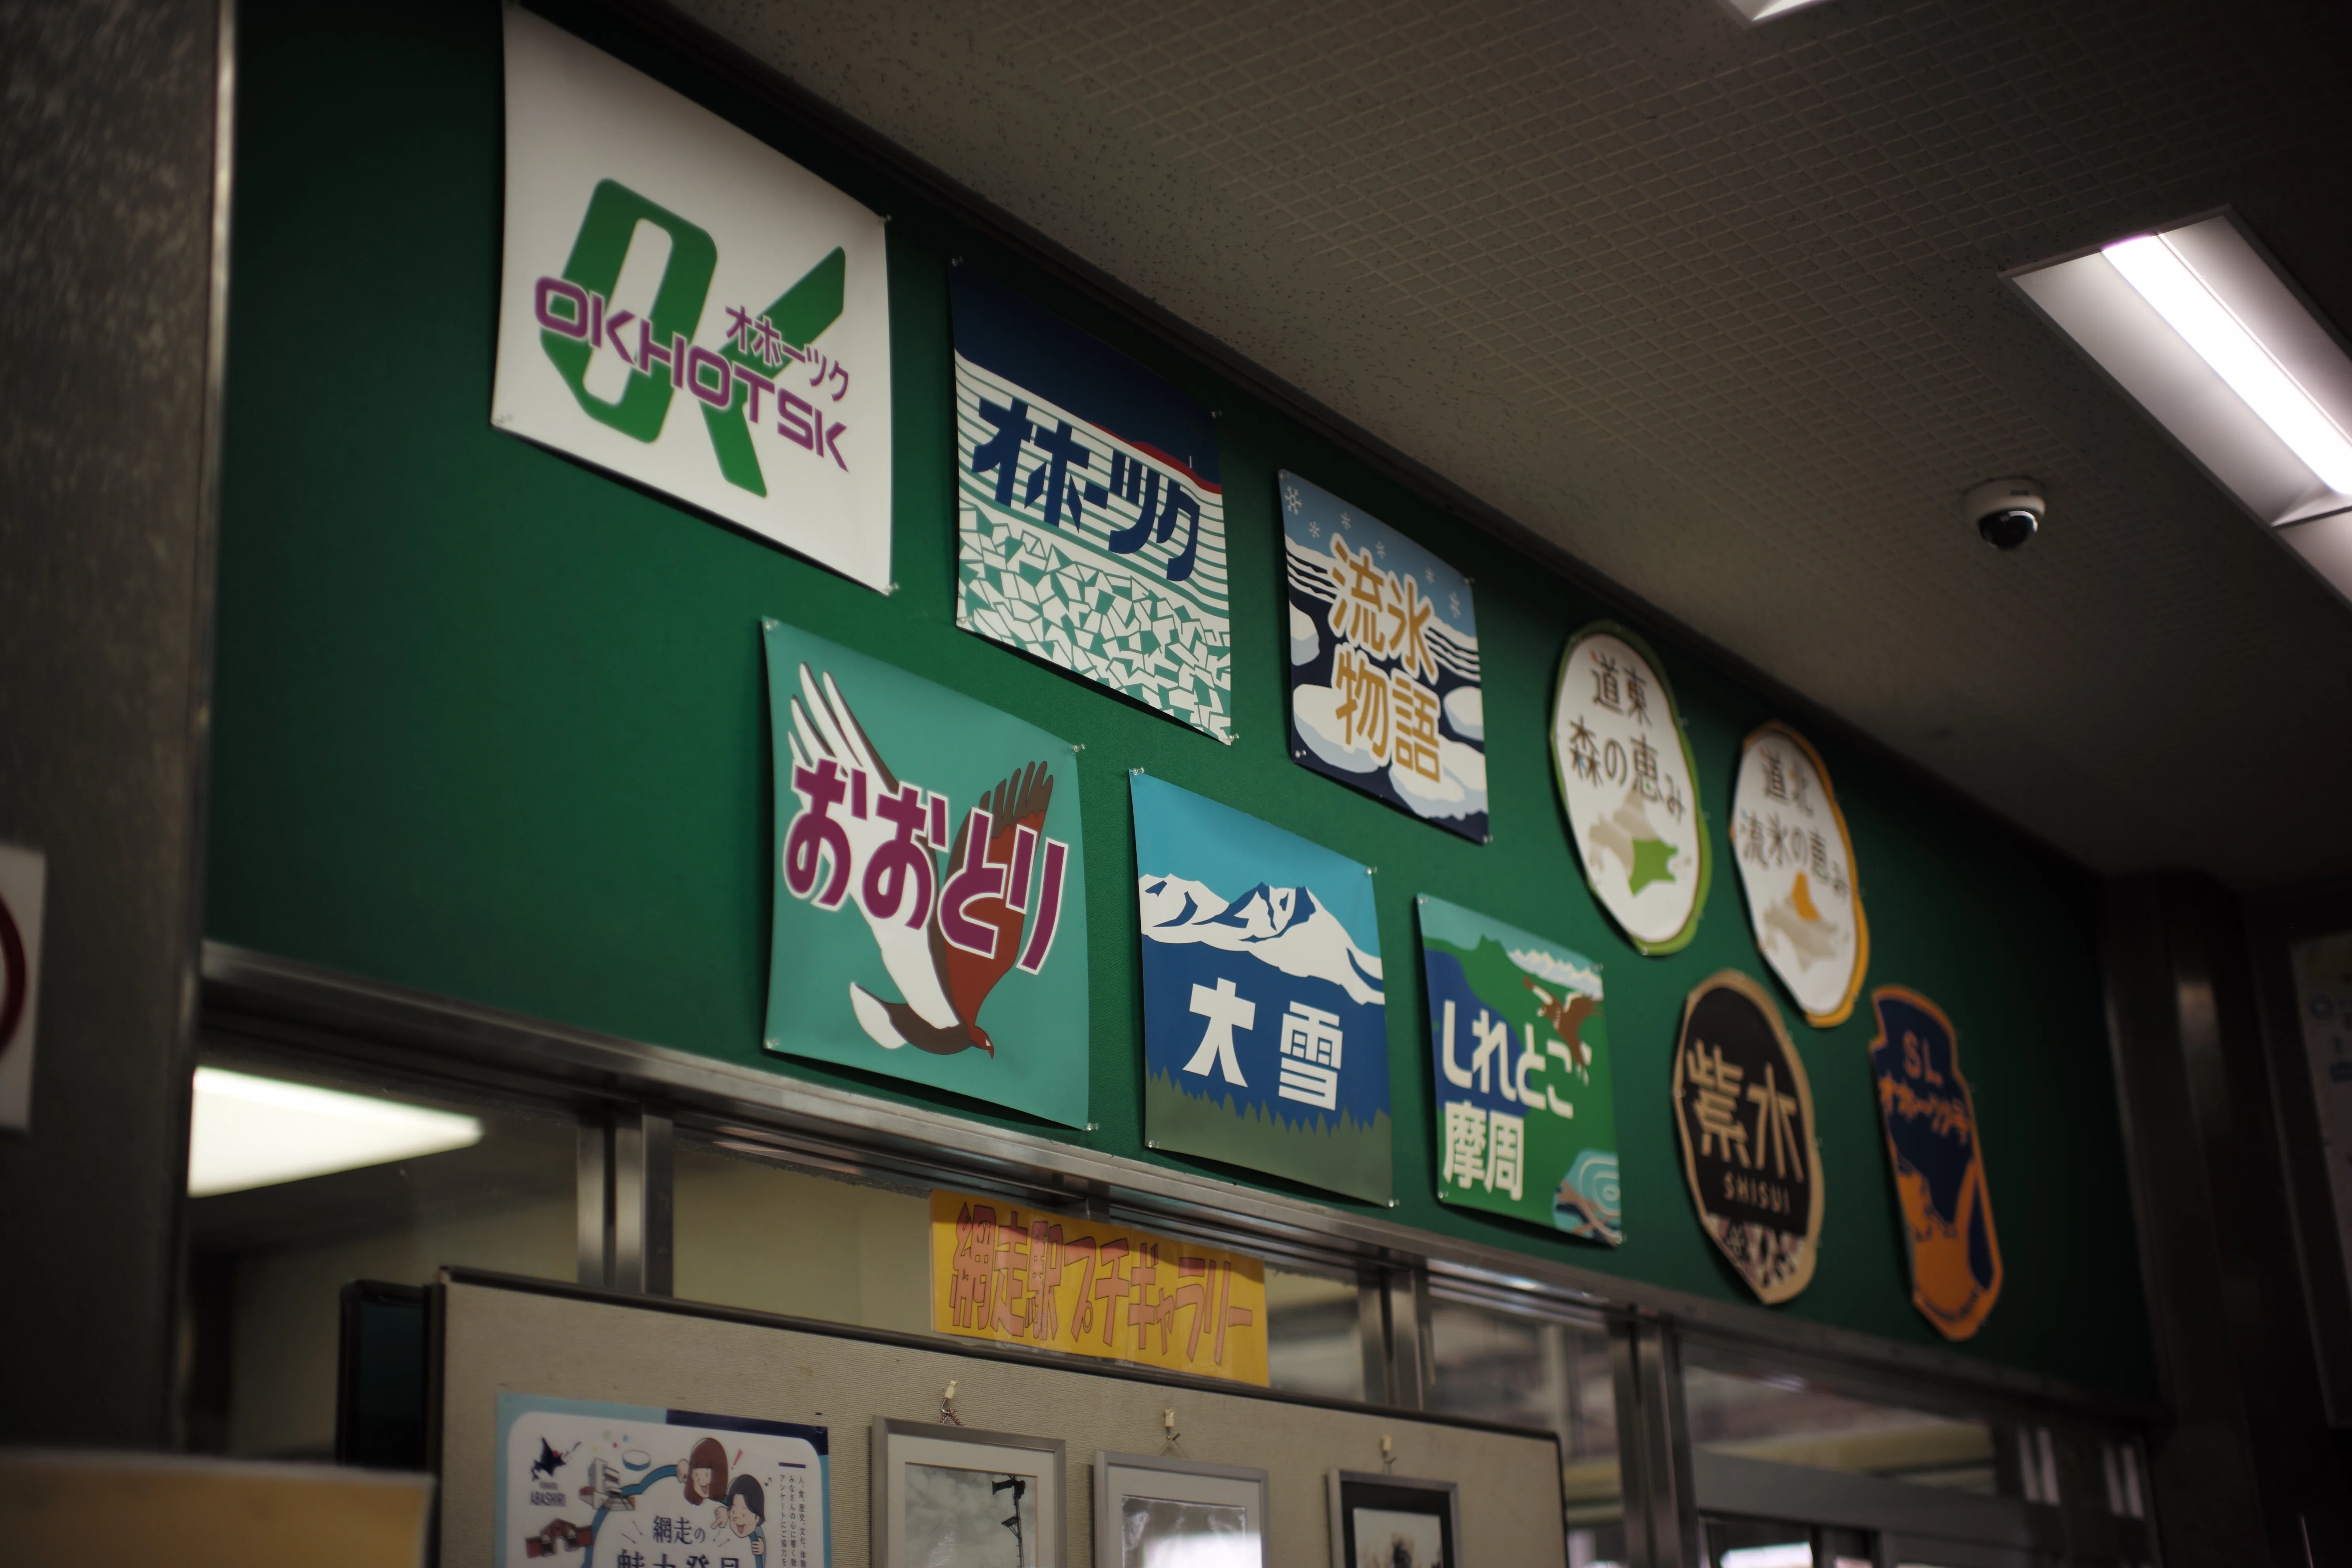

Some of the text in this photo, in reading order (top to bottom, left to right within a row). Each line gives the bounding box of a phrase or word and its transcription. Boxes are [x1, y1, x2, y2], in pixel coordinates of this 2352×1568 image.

[535, 276, 850, 473] OKHOTSK
[726, 305, 849, 401] オホーツク
[972, 398, 1200, 581] オホーツク
[1331, 540, 1436, 677] 流氷
[1336, 651, 1440, 783] 物語
[1589, 649, 1652, 727] 道東
[1569, 714, 1685, 825] 森の恵み
[784, 757, 1067, 974] おおとり
[1183, 977, 1342, 1110] 大雪
[1443, 1000, 1573, 1119] しれとこ
[1903, 1029, 1943, 1086] SL
[1444, 1101, 1525, 1201] 摩周
[1724, 1171, 1790, 1215] SHISUI
[950, 1202, 1252, 1365] 網走駅プチギャラリー
[653, 1515, 705, 1544] 網走の
